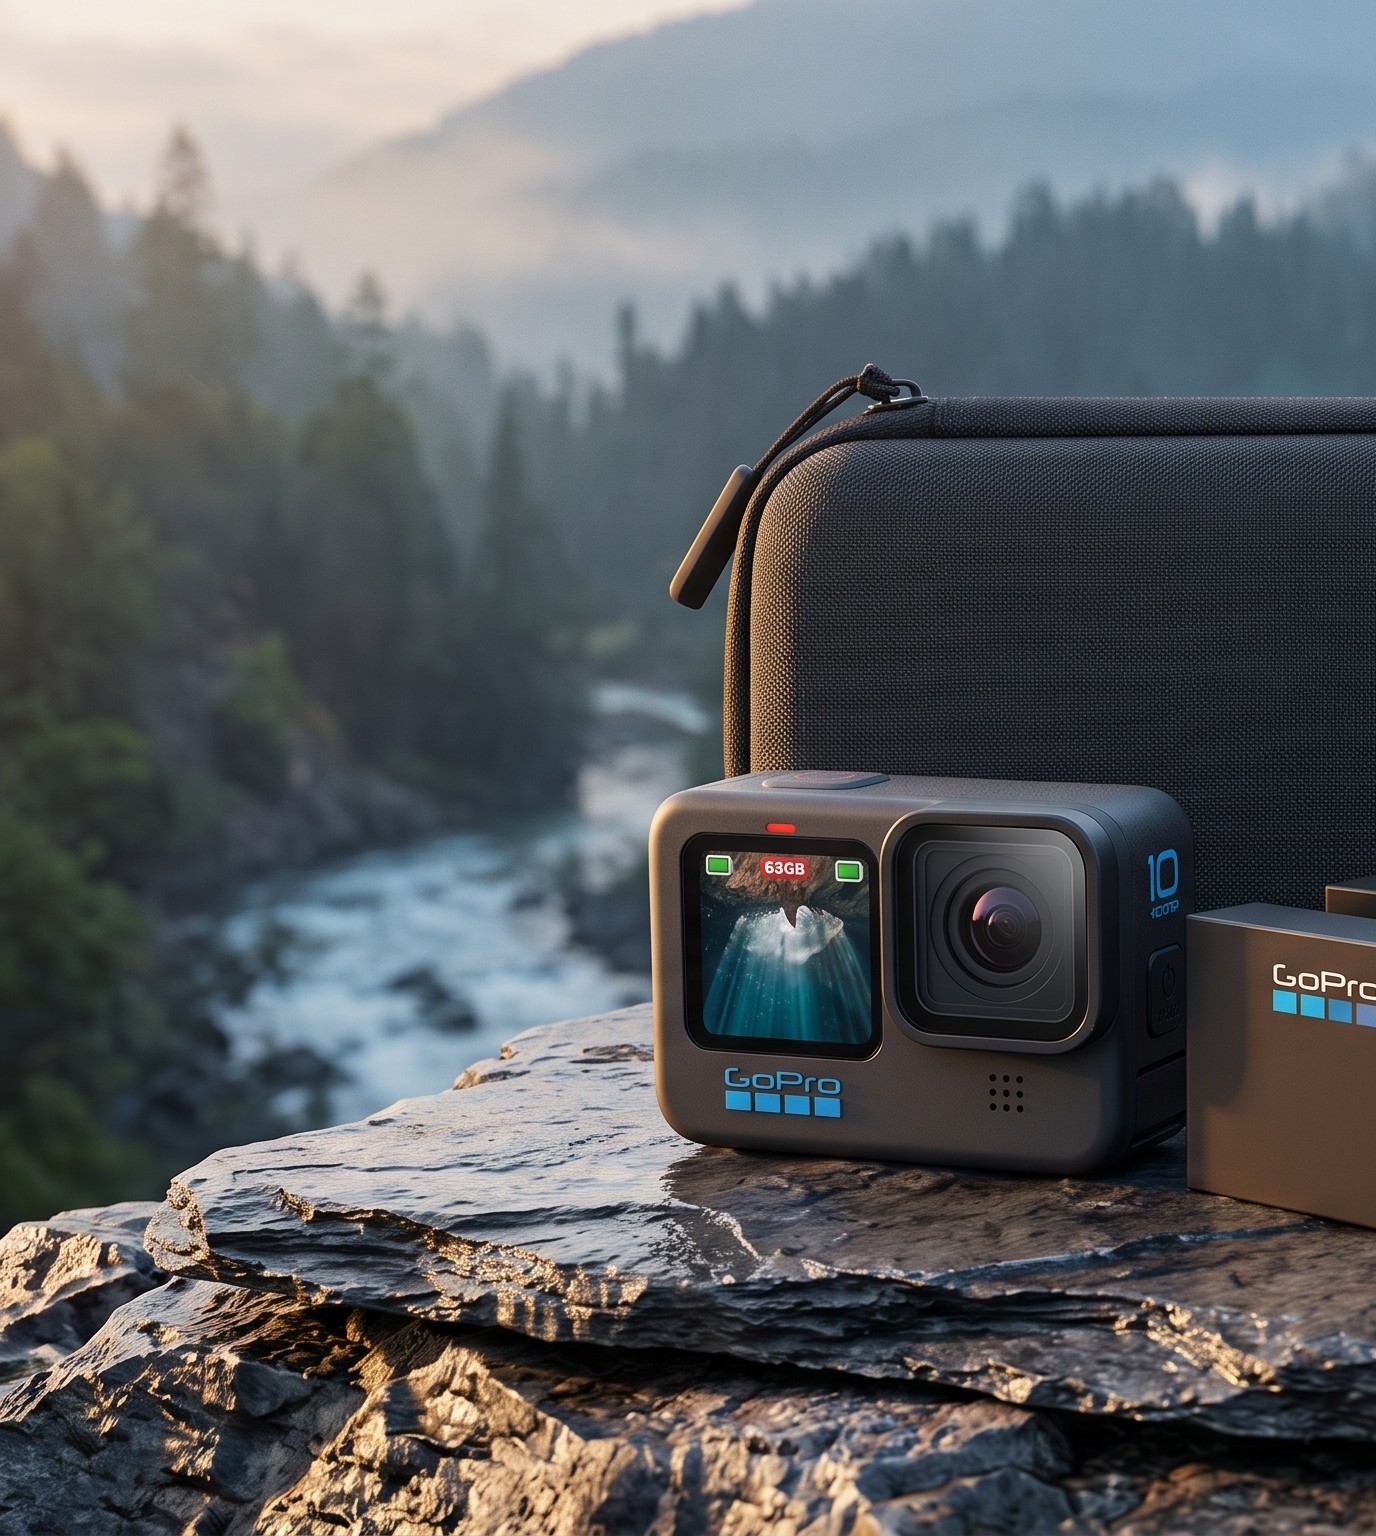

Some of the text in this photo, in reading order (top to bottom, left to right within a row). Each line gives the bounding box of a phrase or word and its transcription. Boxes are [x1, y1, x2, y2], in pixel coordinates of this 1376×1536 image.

[764, 860, 805, 876] 63GB
[1147, 848, 1179, 902] 10
[724, 1067, 841, 1095] GoPro
